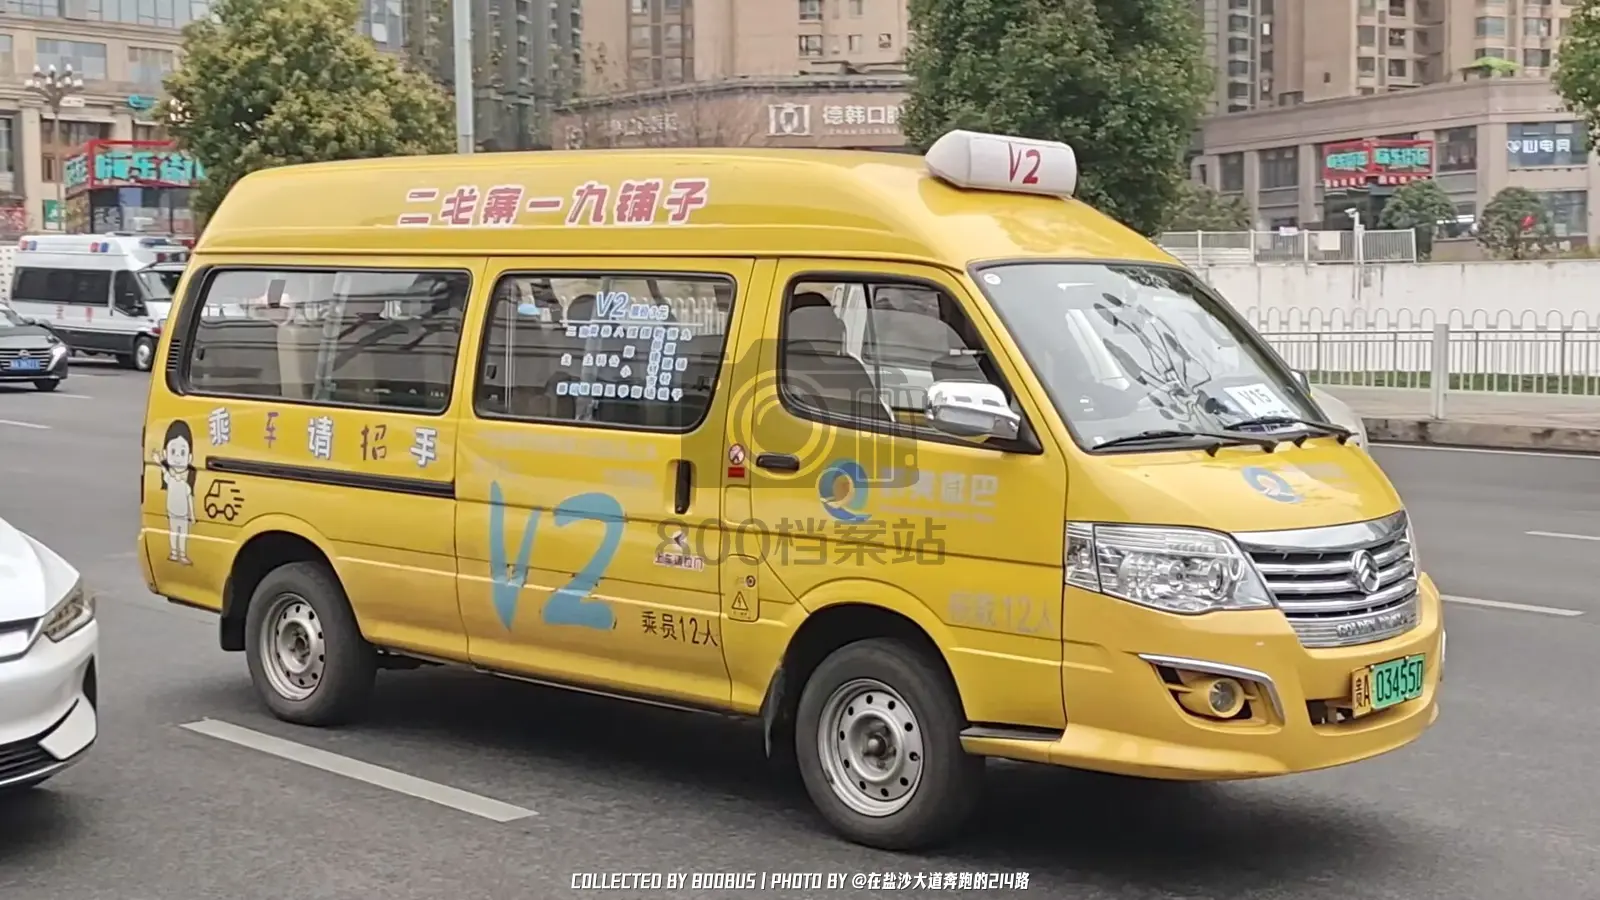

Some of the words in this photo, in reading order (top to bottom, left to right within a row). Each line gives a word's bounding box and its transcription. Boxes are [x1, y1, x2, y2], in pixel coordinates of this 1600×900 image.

[1008, 140, 1041, 184] V2
[596, 291, 629, 318] V2
[208, 407, 438, 468] 乘车请招手
[489, 480, 624, 632] V2
[641, 611, 719, 648] 乘员12人
